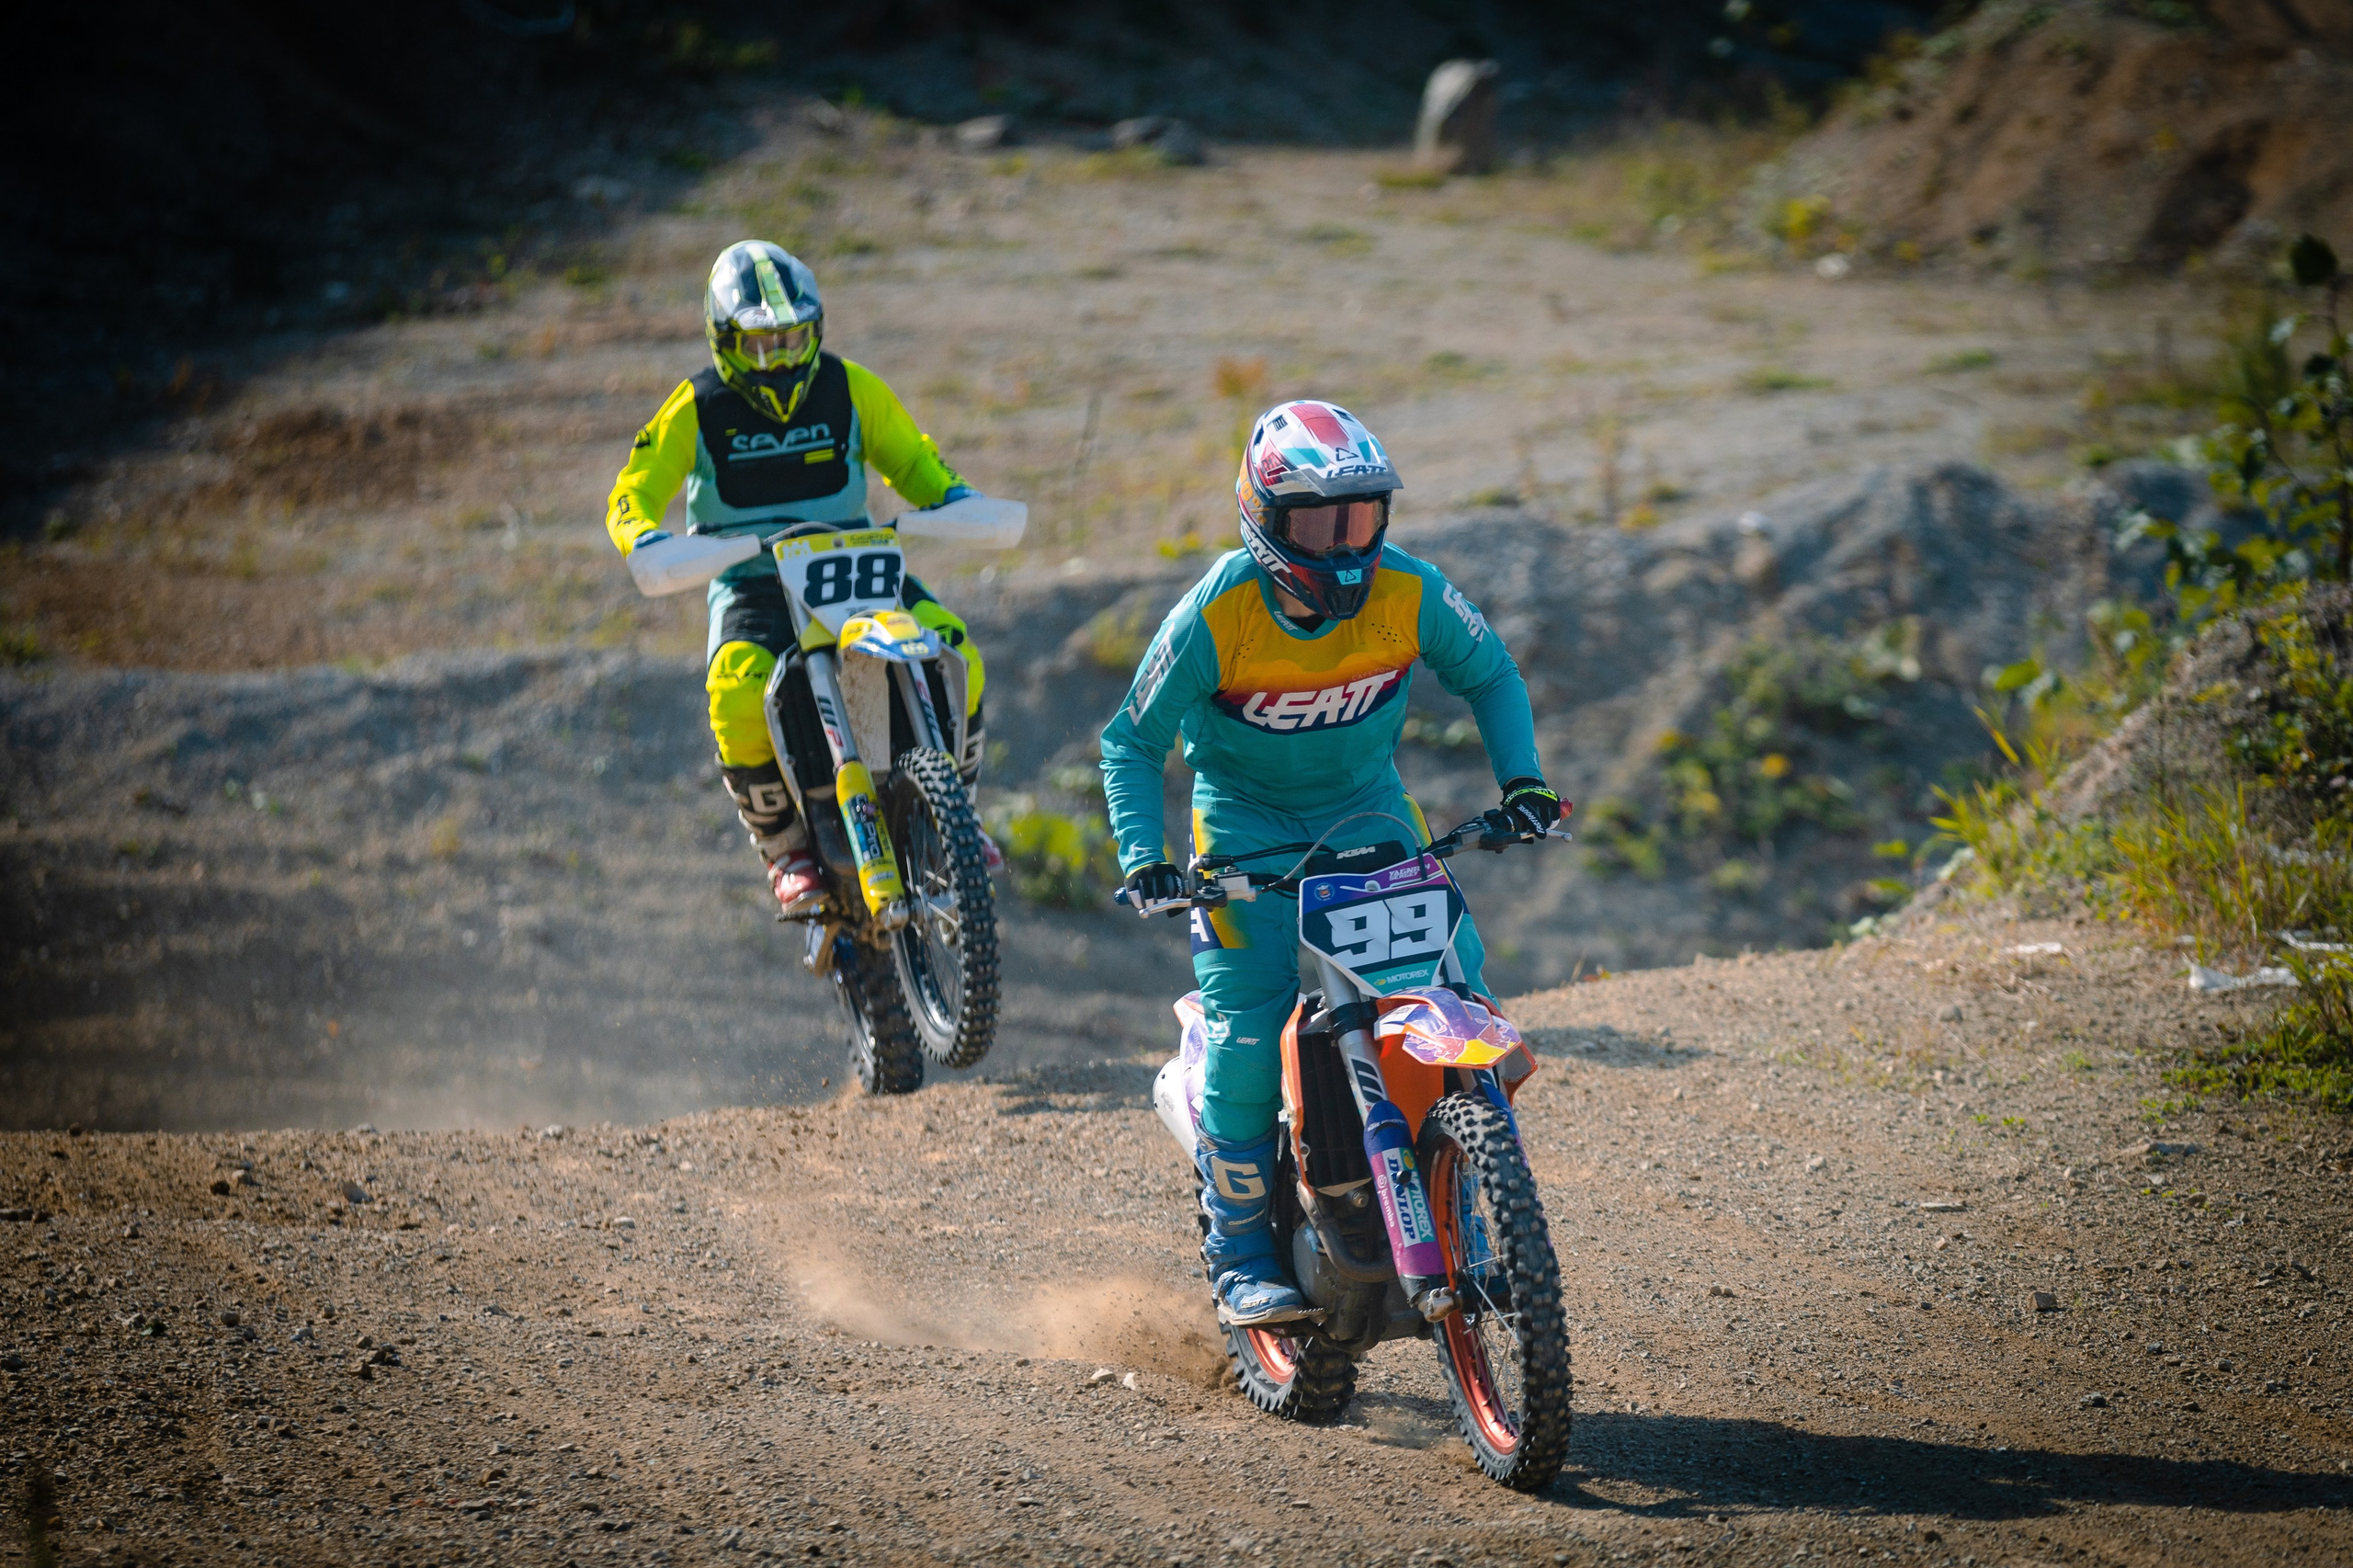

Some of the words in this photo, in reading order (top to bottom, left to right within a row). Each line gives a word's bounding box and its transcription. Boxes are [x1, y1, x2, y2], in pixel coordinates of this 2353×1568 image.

[803, 552, 901, 608] 88
[1243, 669, 1400, 730] LEATT
[748, 783, 790, 814] G
[1336, 846, 1376, 860] KTM
[1324, 890, 1449, 969] 99
[1386, 970, 1429, 983] MOTOREX
[1211, 1155, 1267, 1200] G
[1381, 1187, 1395, 1228] brembo
